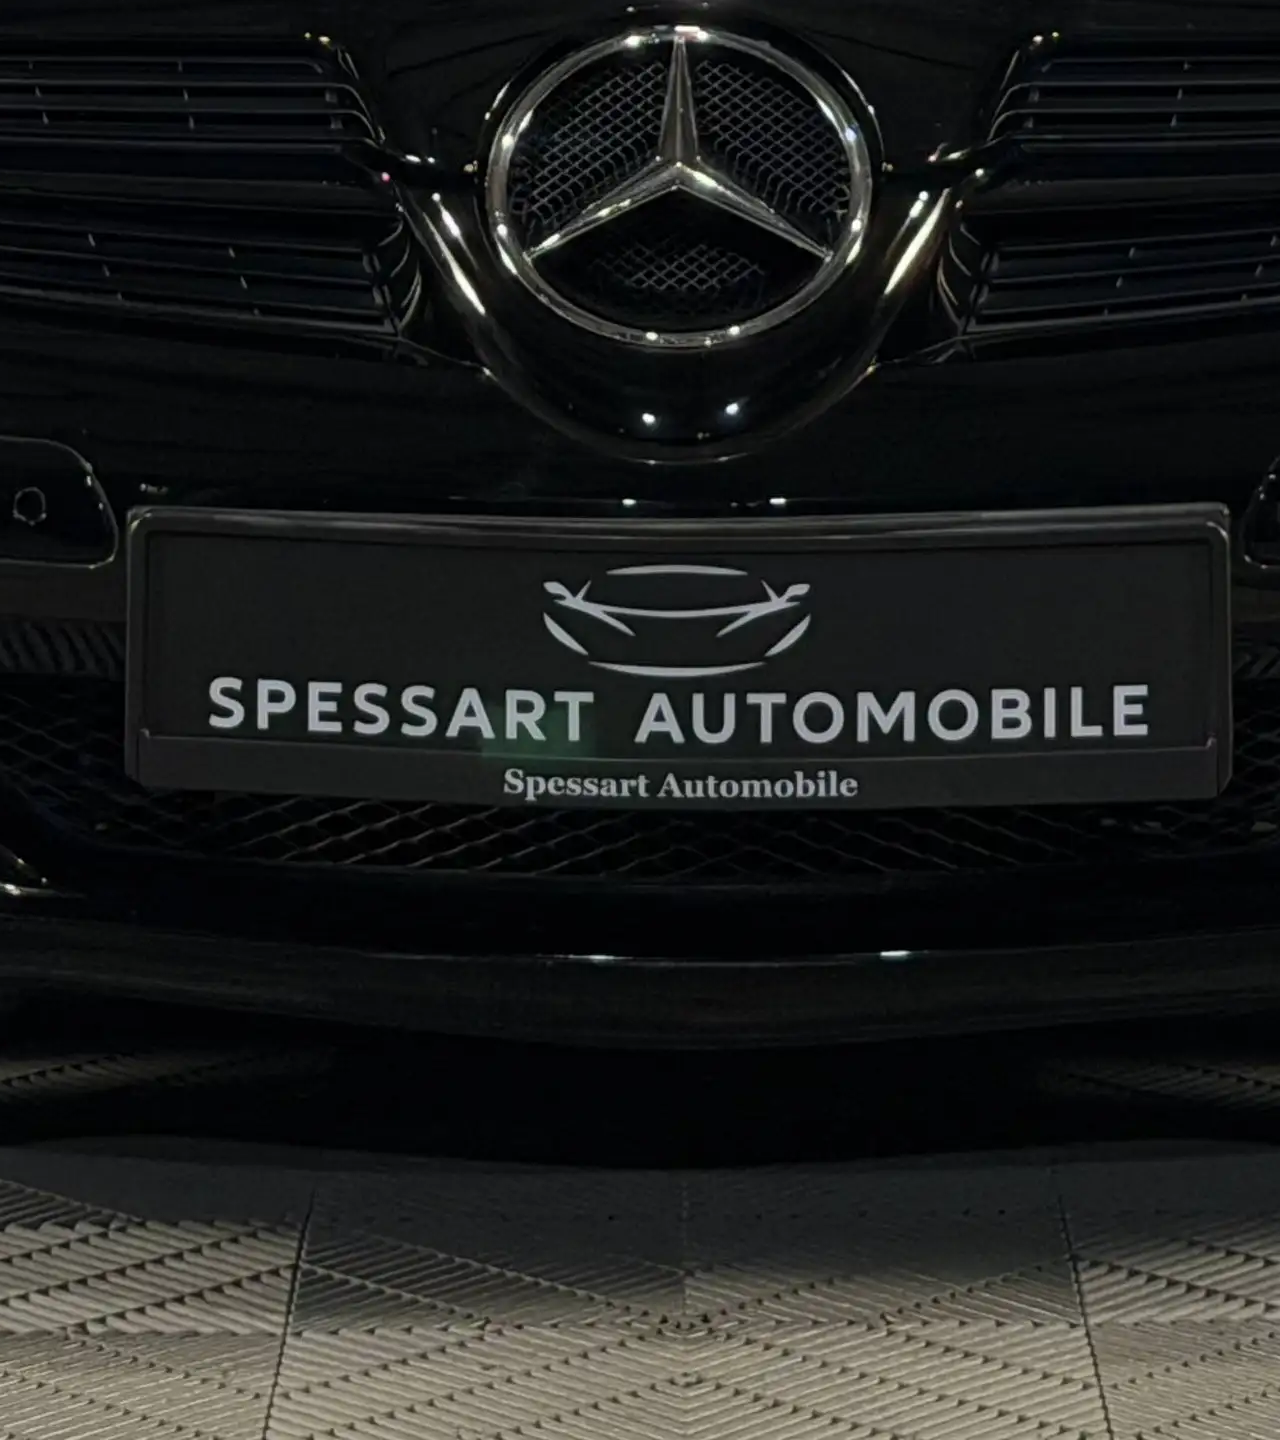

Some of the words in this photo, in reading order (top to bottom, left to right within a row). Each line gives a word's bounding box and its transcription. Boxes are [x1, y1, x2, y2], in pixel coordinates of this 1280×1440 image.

[208, 676, 595, 742] SPESSART
[634, 683, 1150, 744] AUTOMOBILE
[503, 768, 650, 803] Spessart
[657, 770, 859, 799] Automobile
